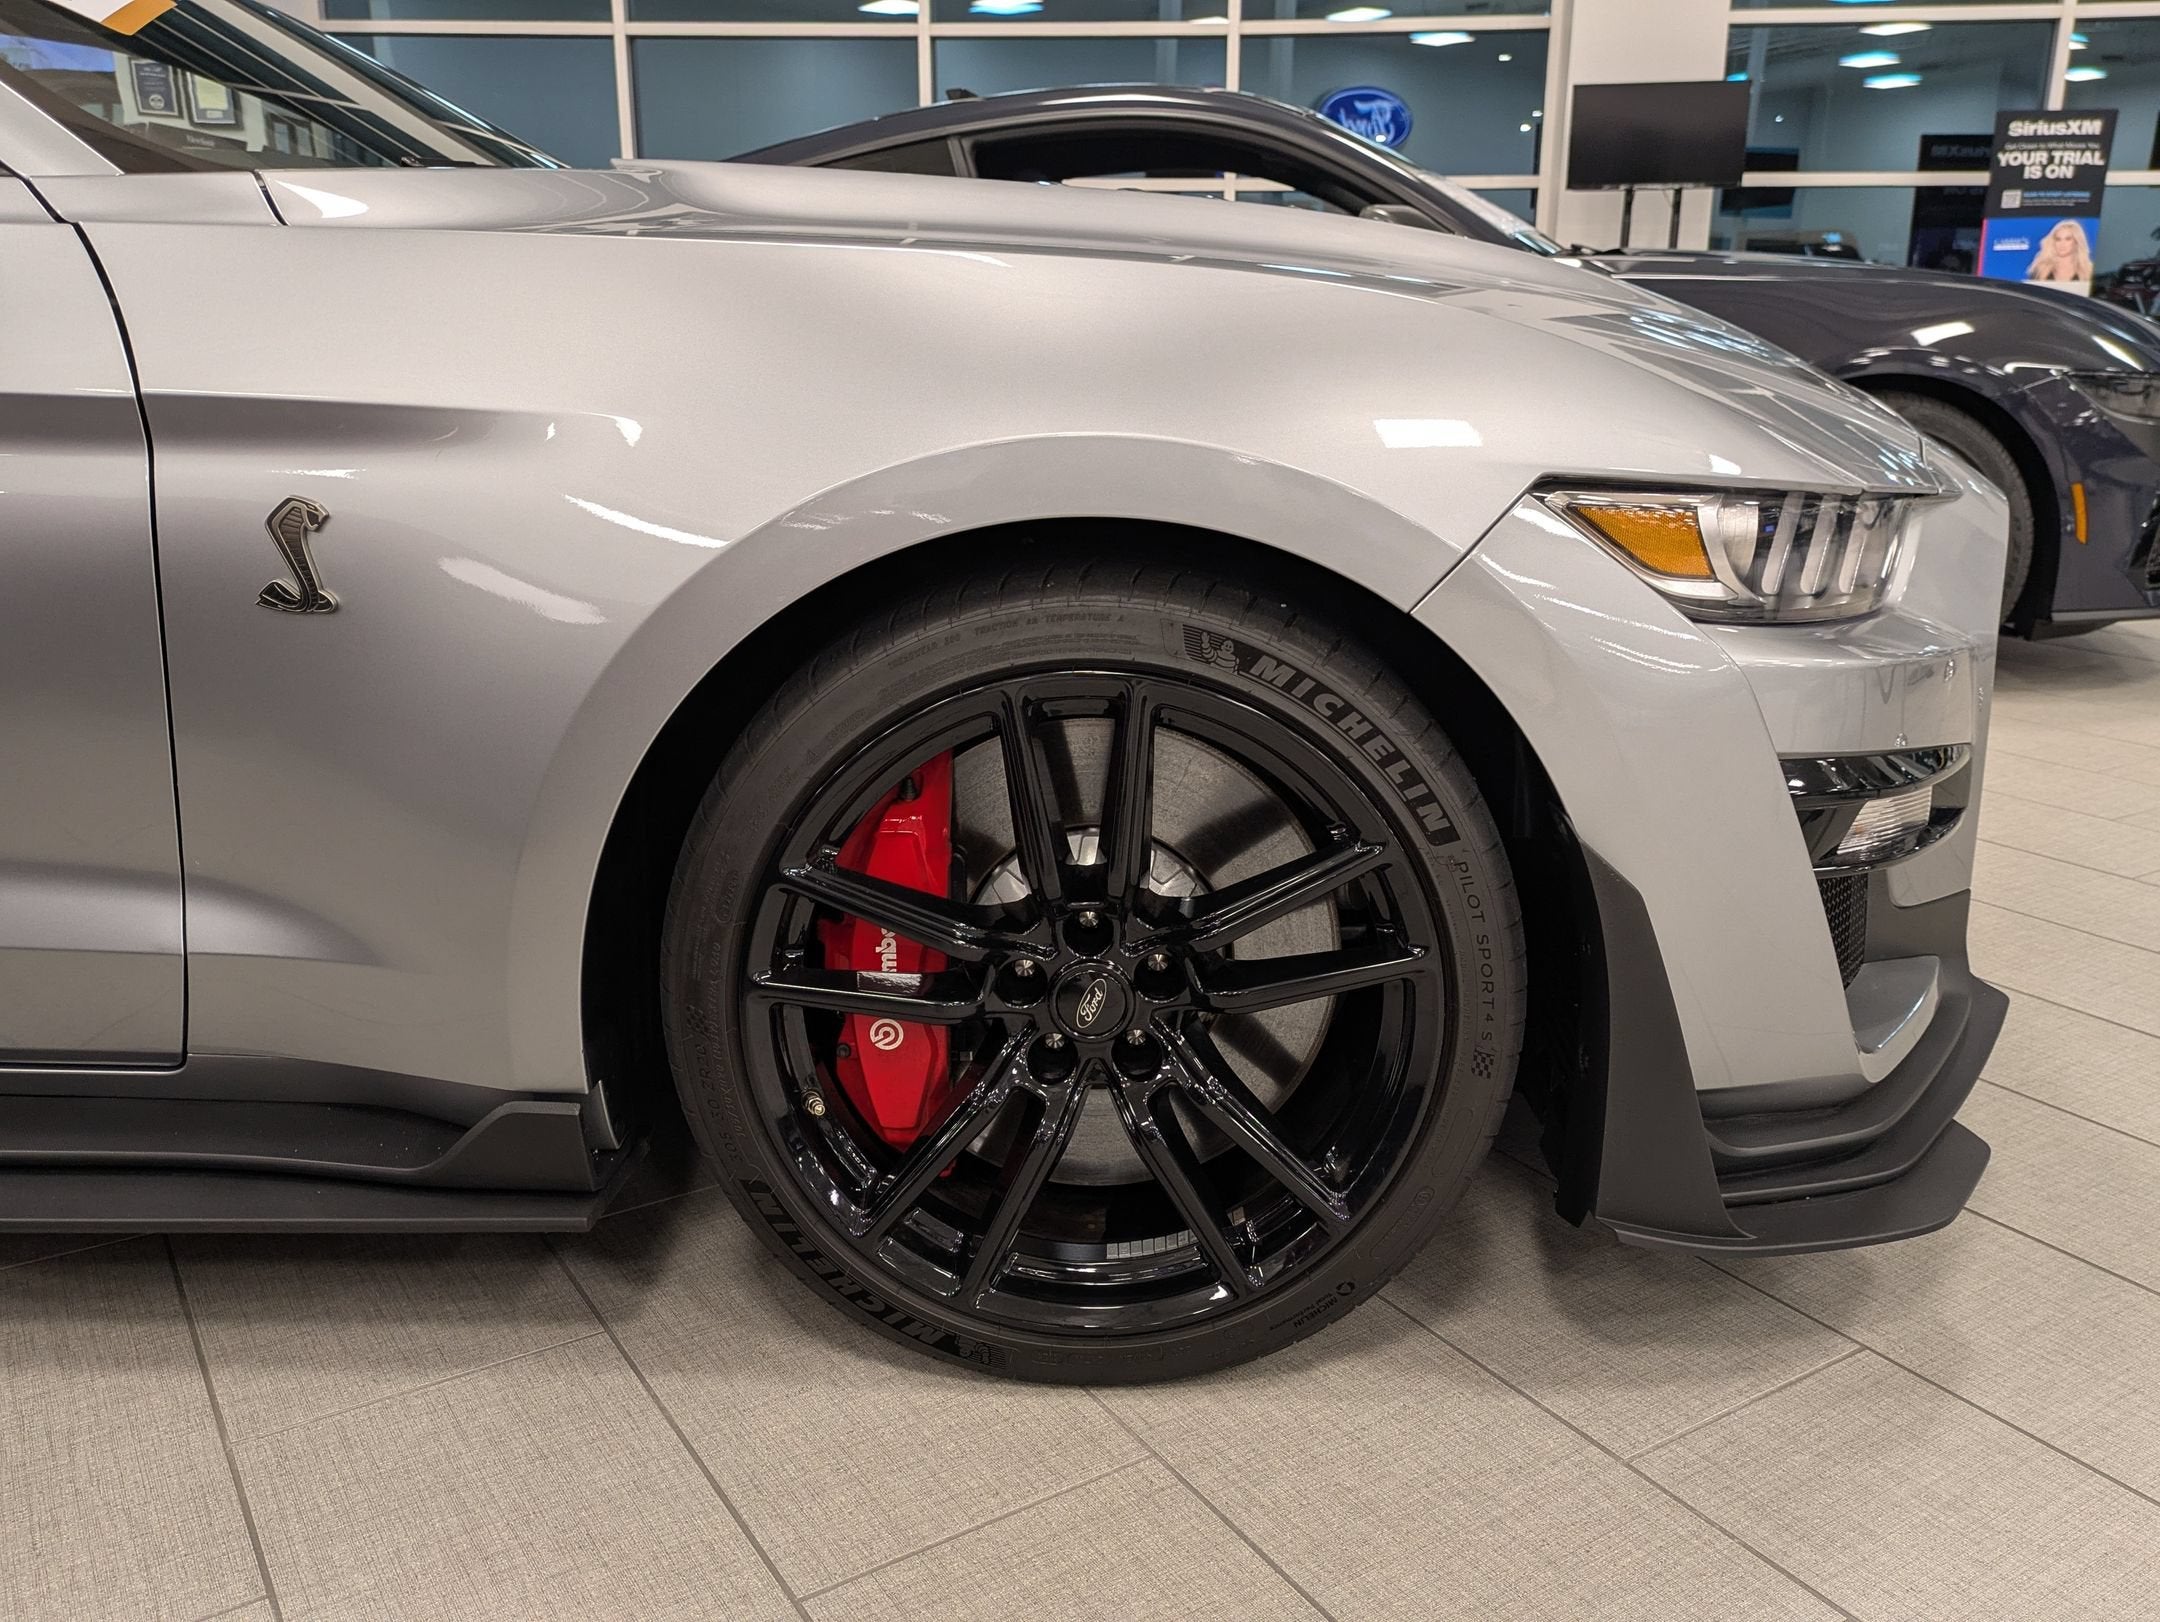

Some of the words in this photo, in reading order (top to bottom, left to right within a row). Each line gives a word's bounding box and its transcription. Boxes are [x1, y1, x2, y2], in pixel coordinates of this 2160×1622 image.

[2008, 119, 2102, 136] SiriusXM
[1997, 150, 2049, 166] YOUR
[2051, 150, 2104, 165] TRIAL
[2023, 165, 2042, 179] IS
[2044, 164, 2075, 179] ON
[1250, 655, 1450, 832] MICHELIN
[1454, 861, 1486, 922] PILOT
[1476, 934, 1496, 1009] SPORT
[1080, 987, 1104, 1021] Ford
[1485, 1013, 1494, 1023] 4
[1481, 1032, 1493, 1041] S
[751, 1192, 945, 1344] MICHELIN
[1294, 1296, 1338, 1328] MICHELIN
